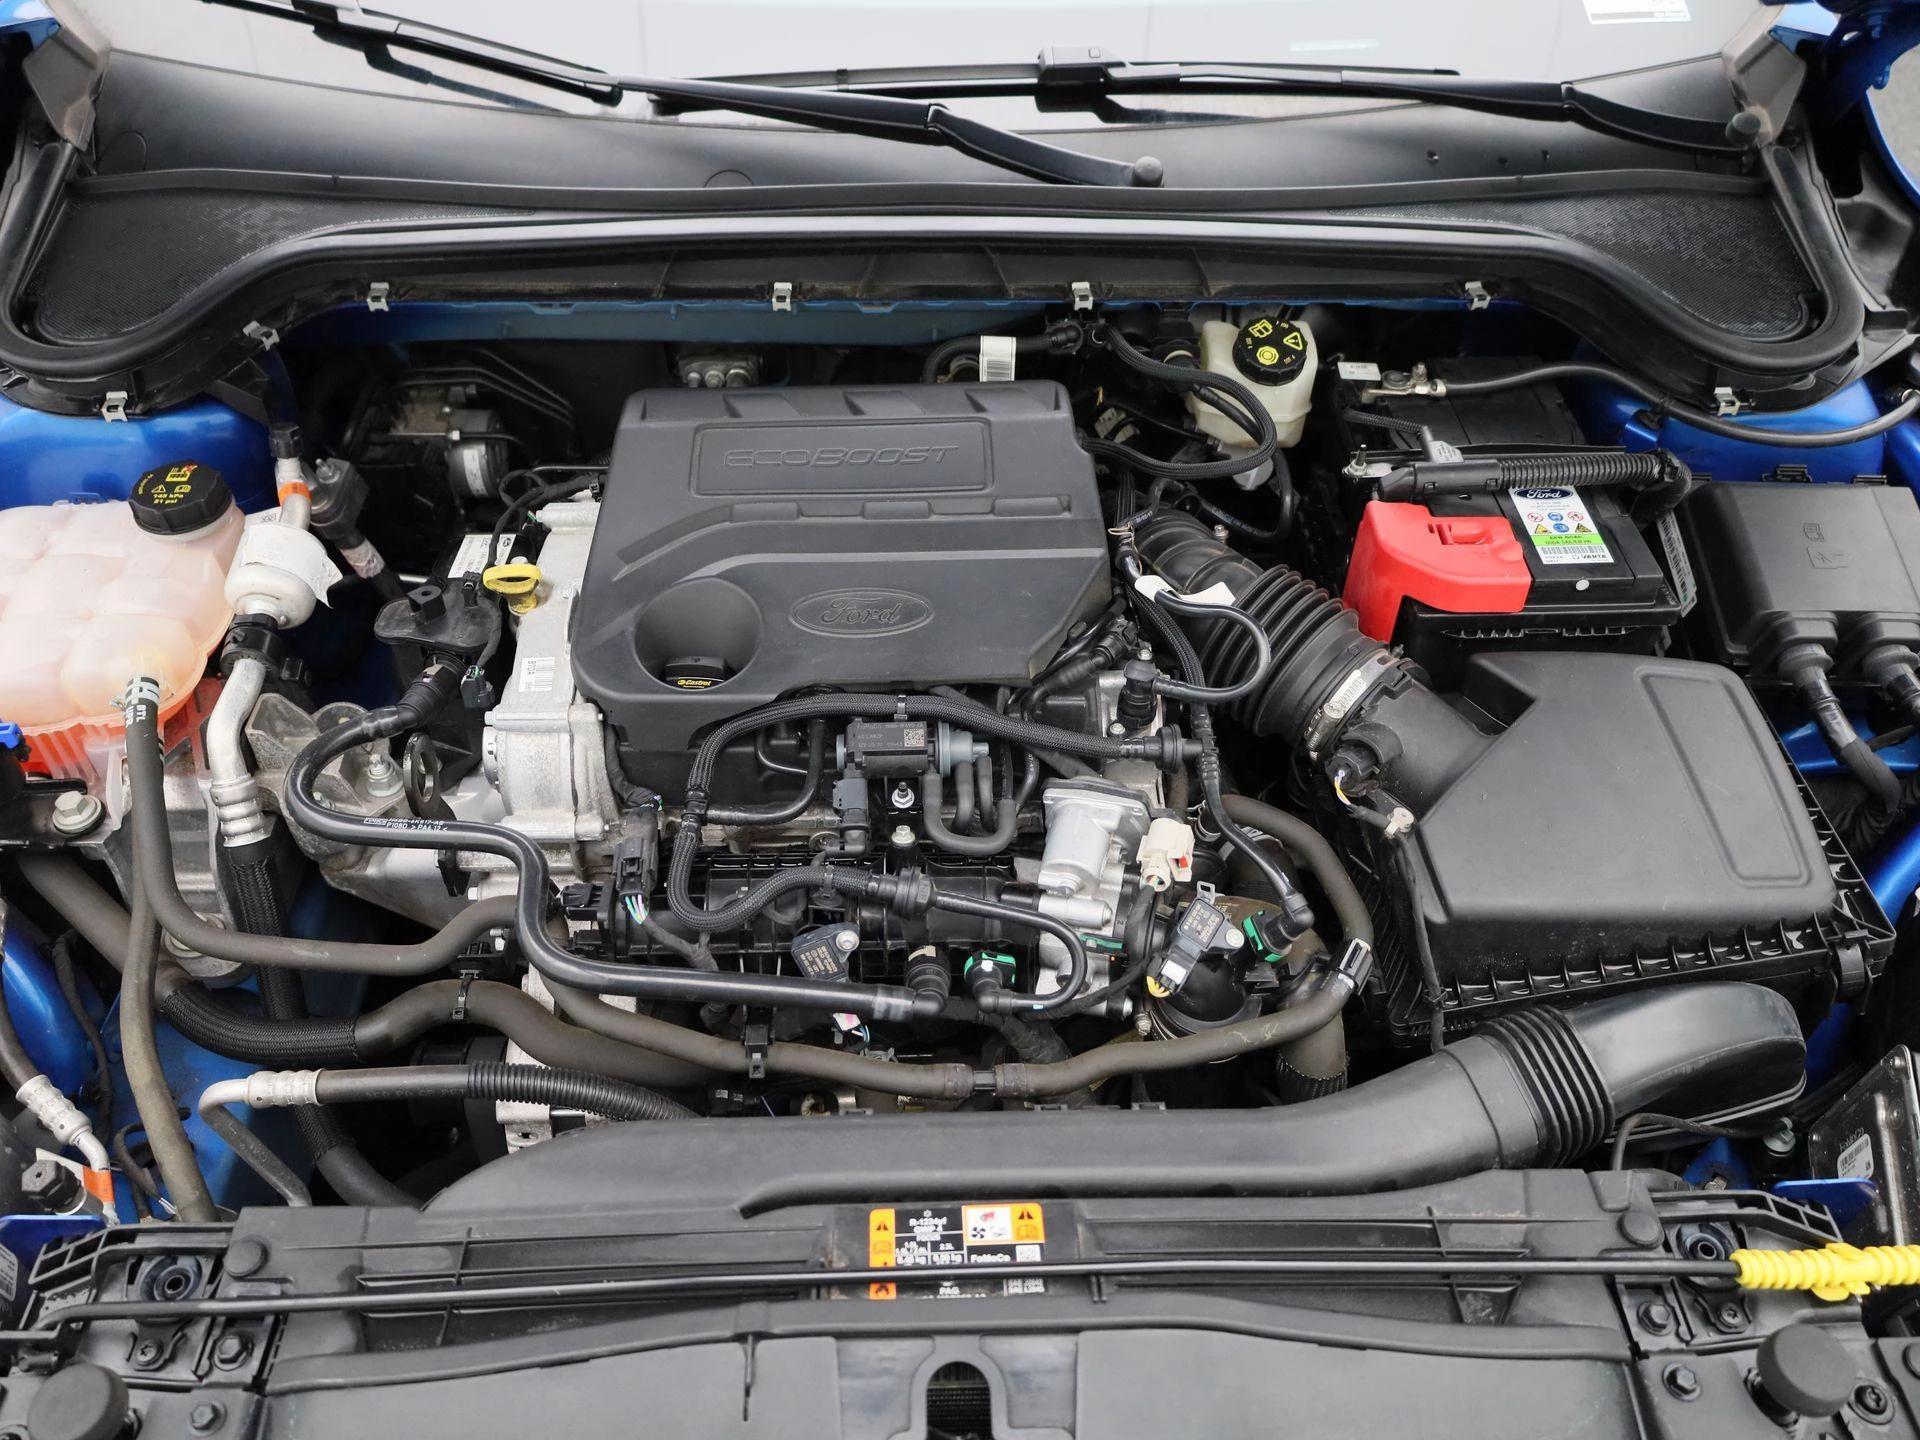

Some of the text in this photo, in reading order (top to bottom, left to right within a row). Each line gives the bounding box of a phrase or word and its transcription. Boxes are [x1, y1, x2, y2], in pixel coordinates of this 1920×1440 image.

[1526, 488, 1563, 499] Ford
[820, 597, 903, 624] Ford
[970, 1253, 1011, 1263] FoMoCo
